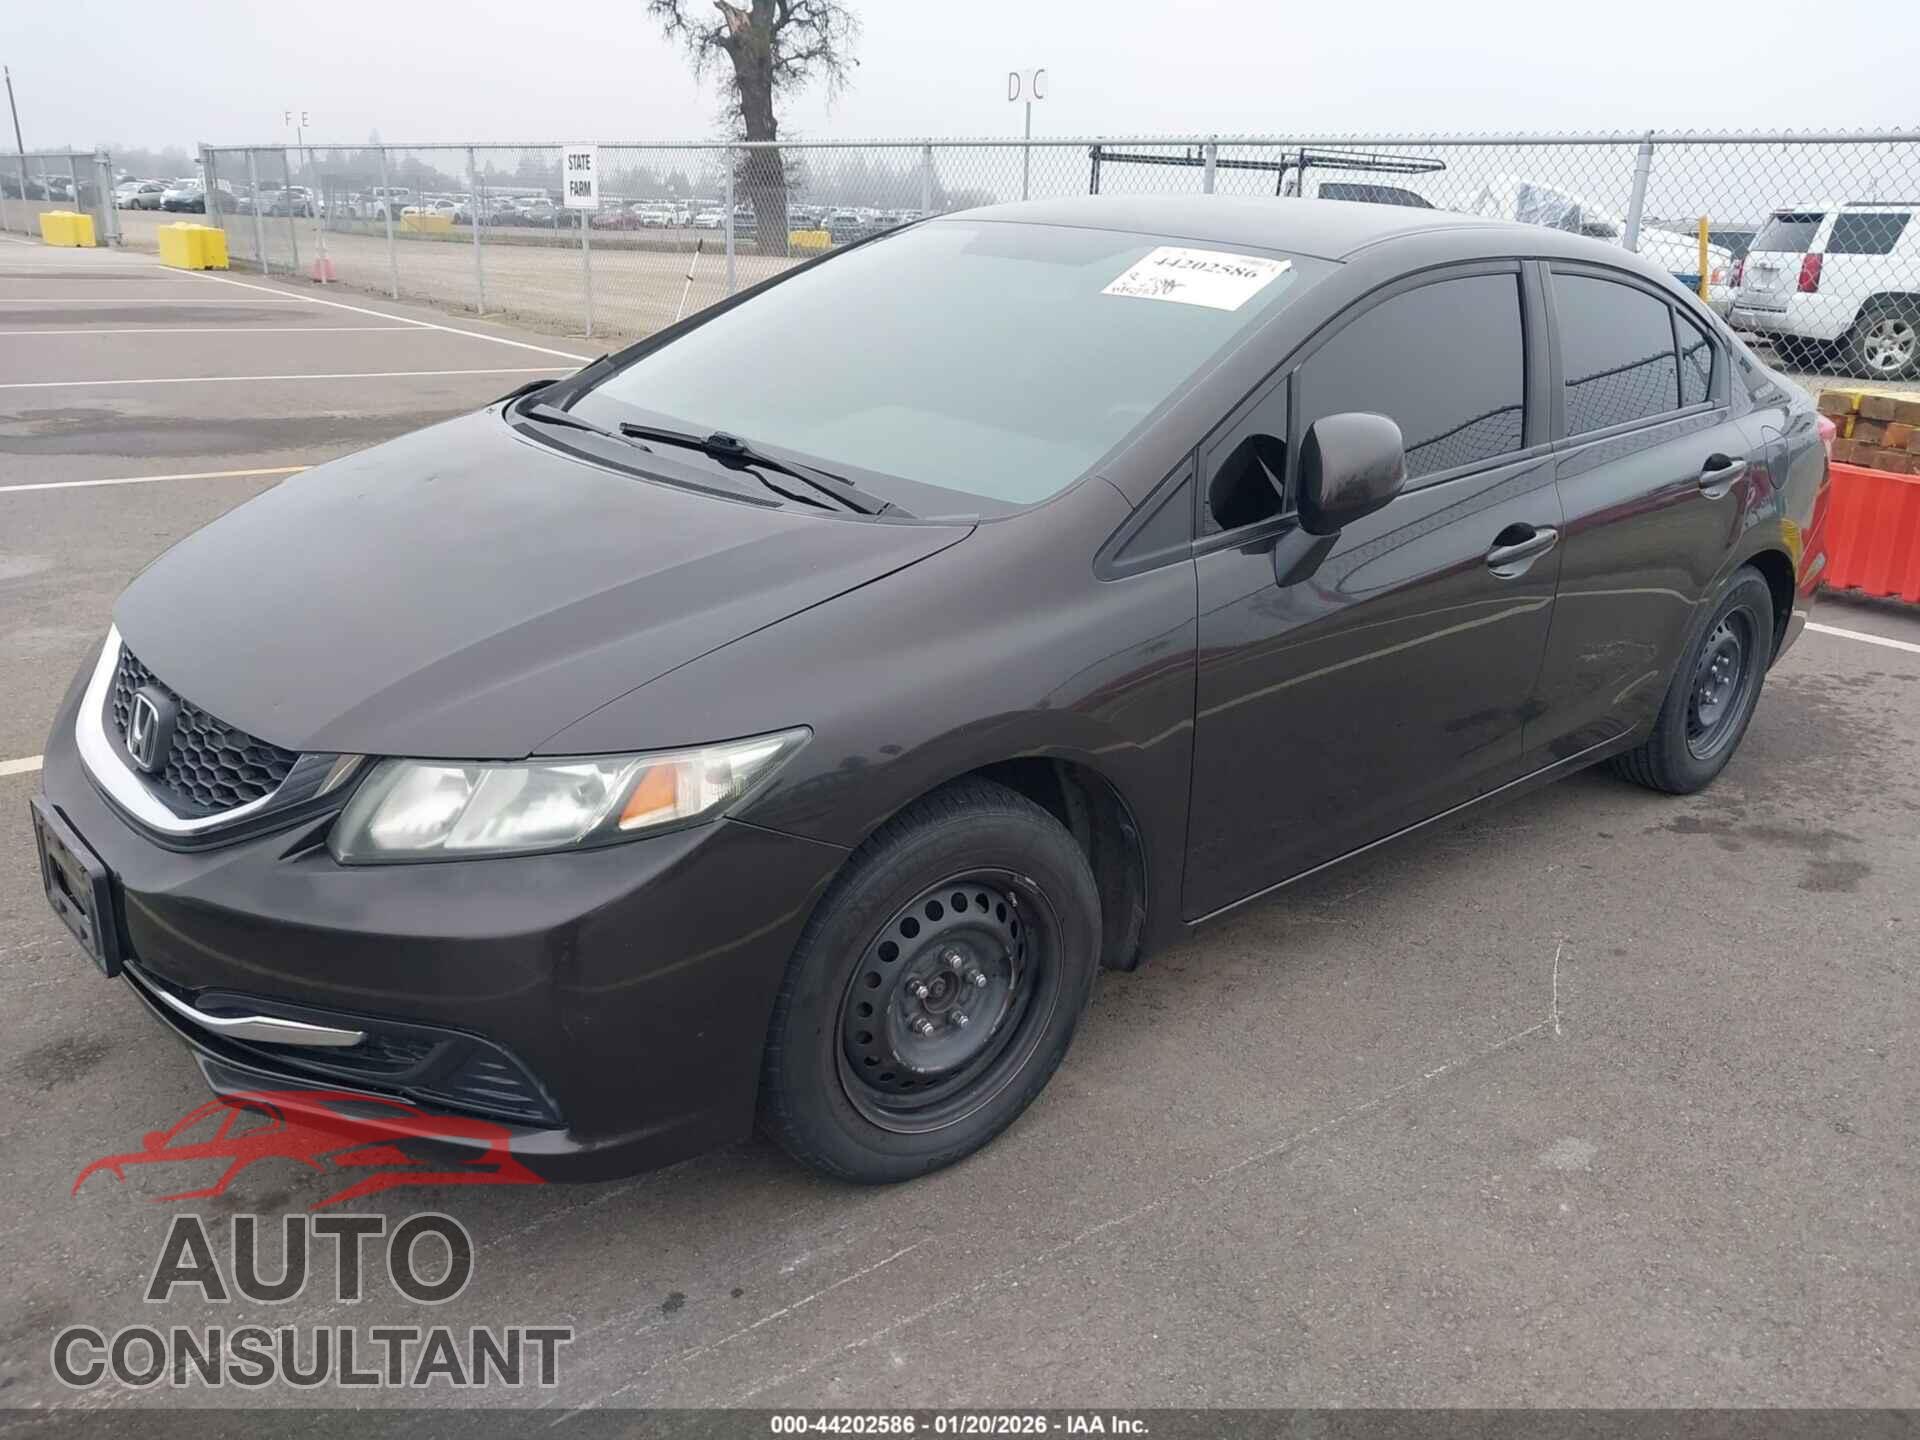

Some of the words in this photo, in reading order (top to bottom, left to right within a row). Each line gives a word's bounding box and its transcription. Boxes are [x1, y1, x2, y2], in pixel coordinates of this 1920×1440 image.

[1008, 72, 1021, 101] D
[1033, 69, 1045, 99] C
[301, 111, 310, 128] E
[568, 154, 591, 170] STATE
[569, 180, 592, 197] FARM
[1153, 257, 1258, 279] 44202586
